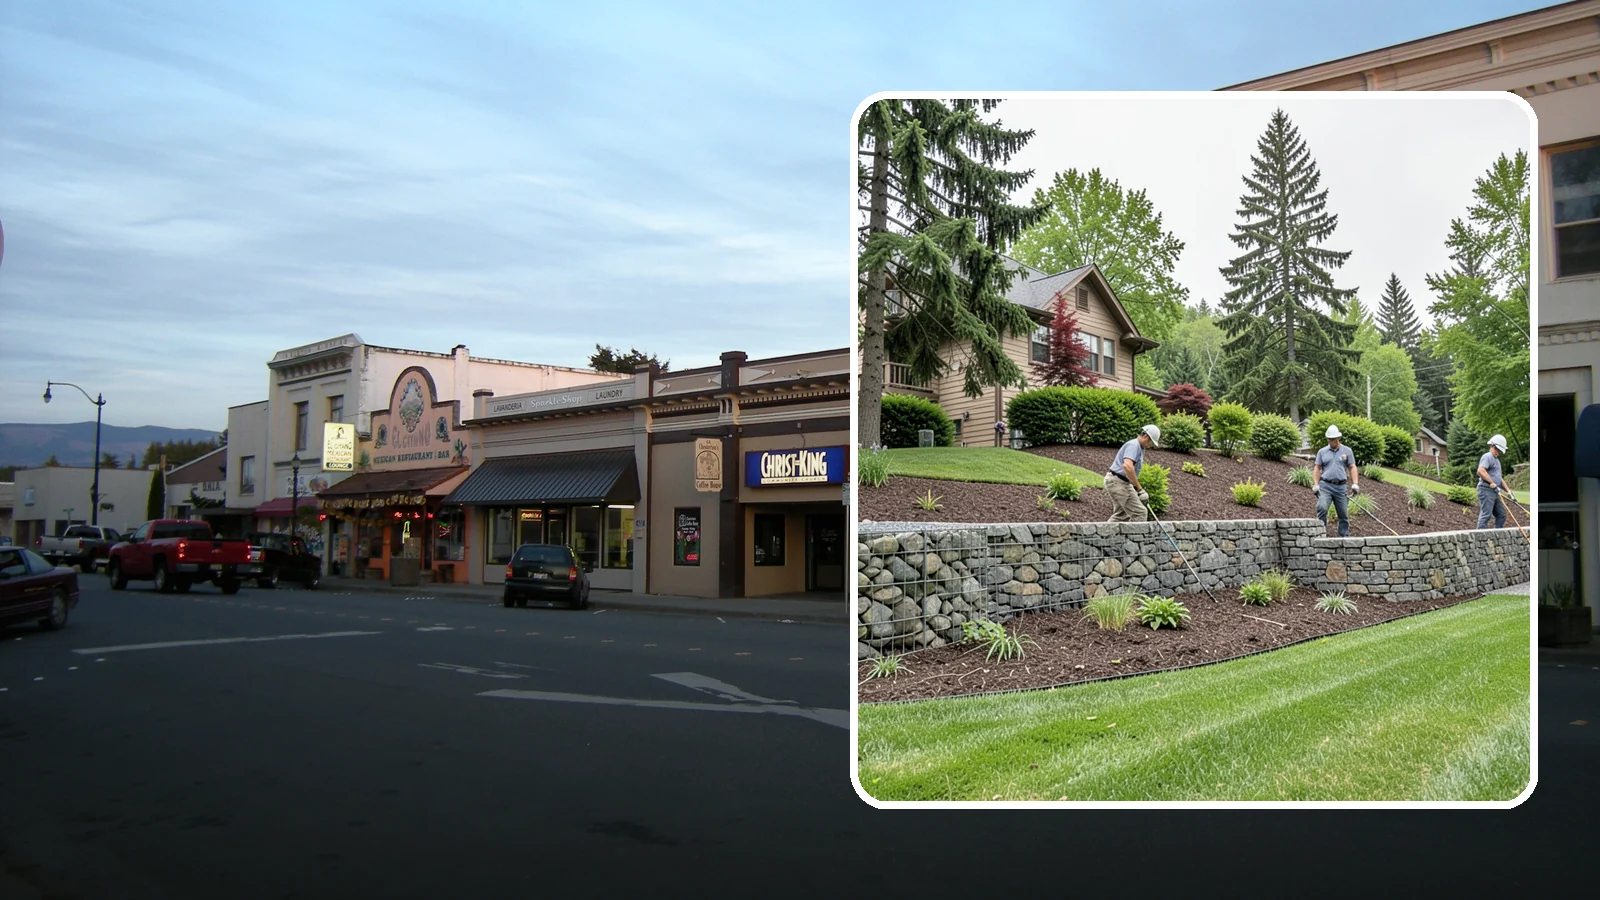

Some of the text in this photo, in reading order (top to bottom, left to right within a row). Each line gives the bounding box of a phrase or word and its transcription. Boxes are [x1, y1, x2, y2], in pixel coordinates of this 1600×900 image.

[530, 394, 583, 409] Sparkle Shop
[595, 389, 623, 400] LAUNDRY
[493, 402, 522, 413] LAVANDERIA
[373, 454, 396, 464] MEXICAN
[397, 451, 434, 462] RESTAURANT
[437, 450, 450, 459] BAR
[761, 450, 827, 478] CHRIST KING
